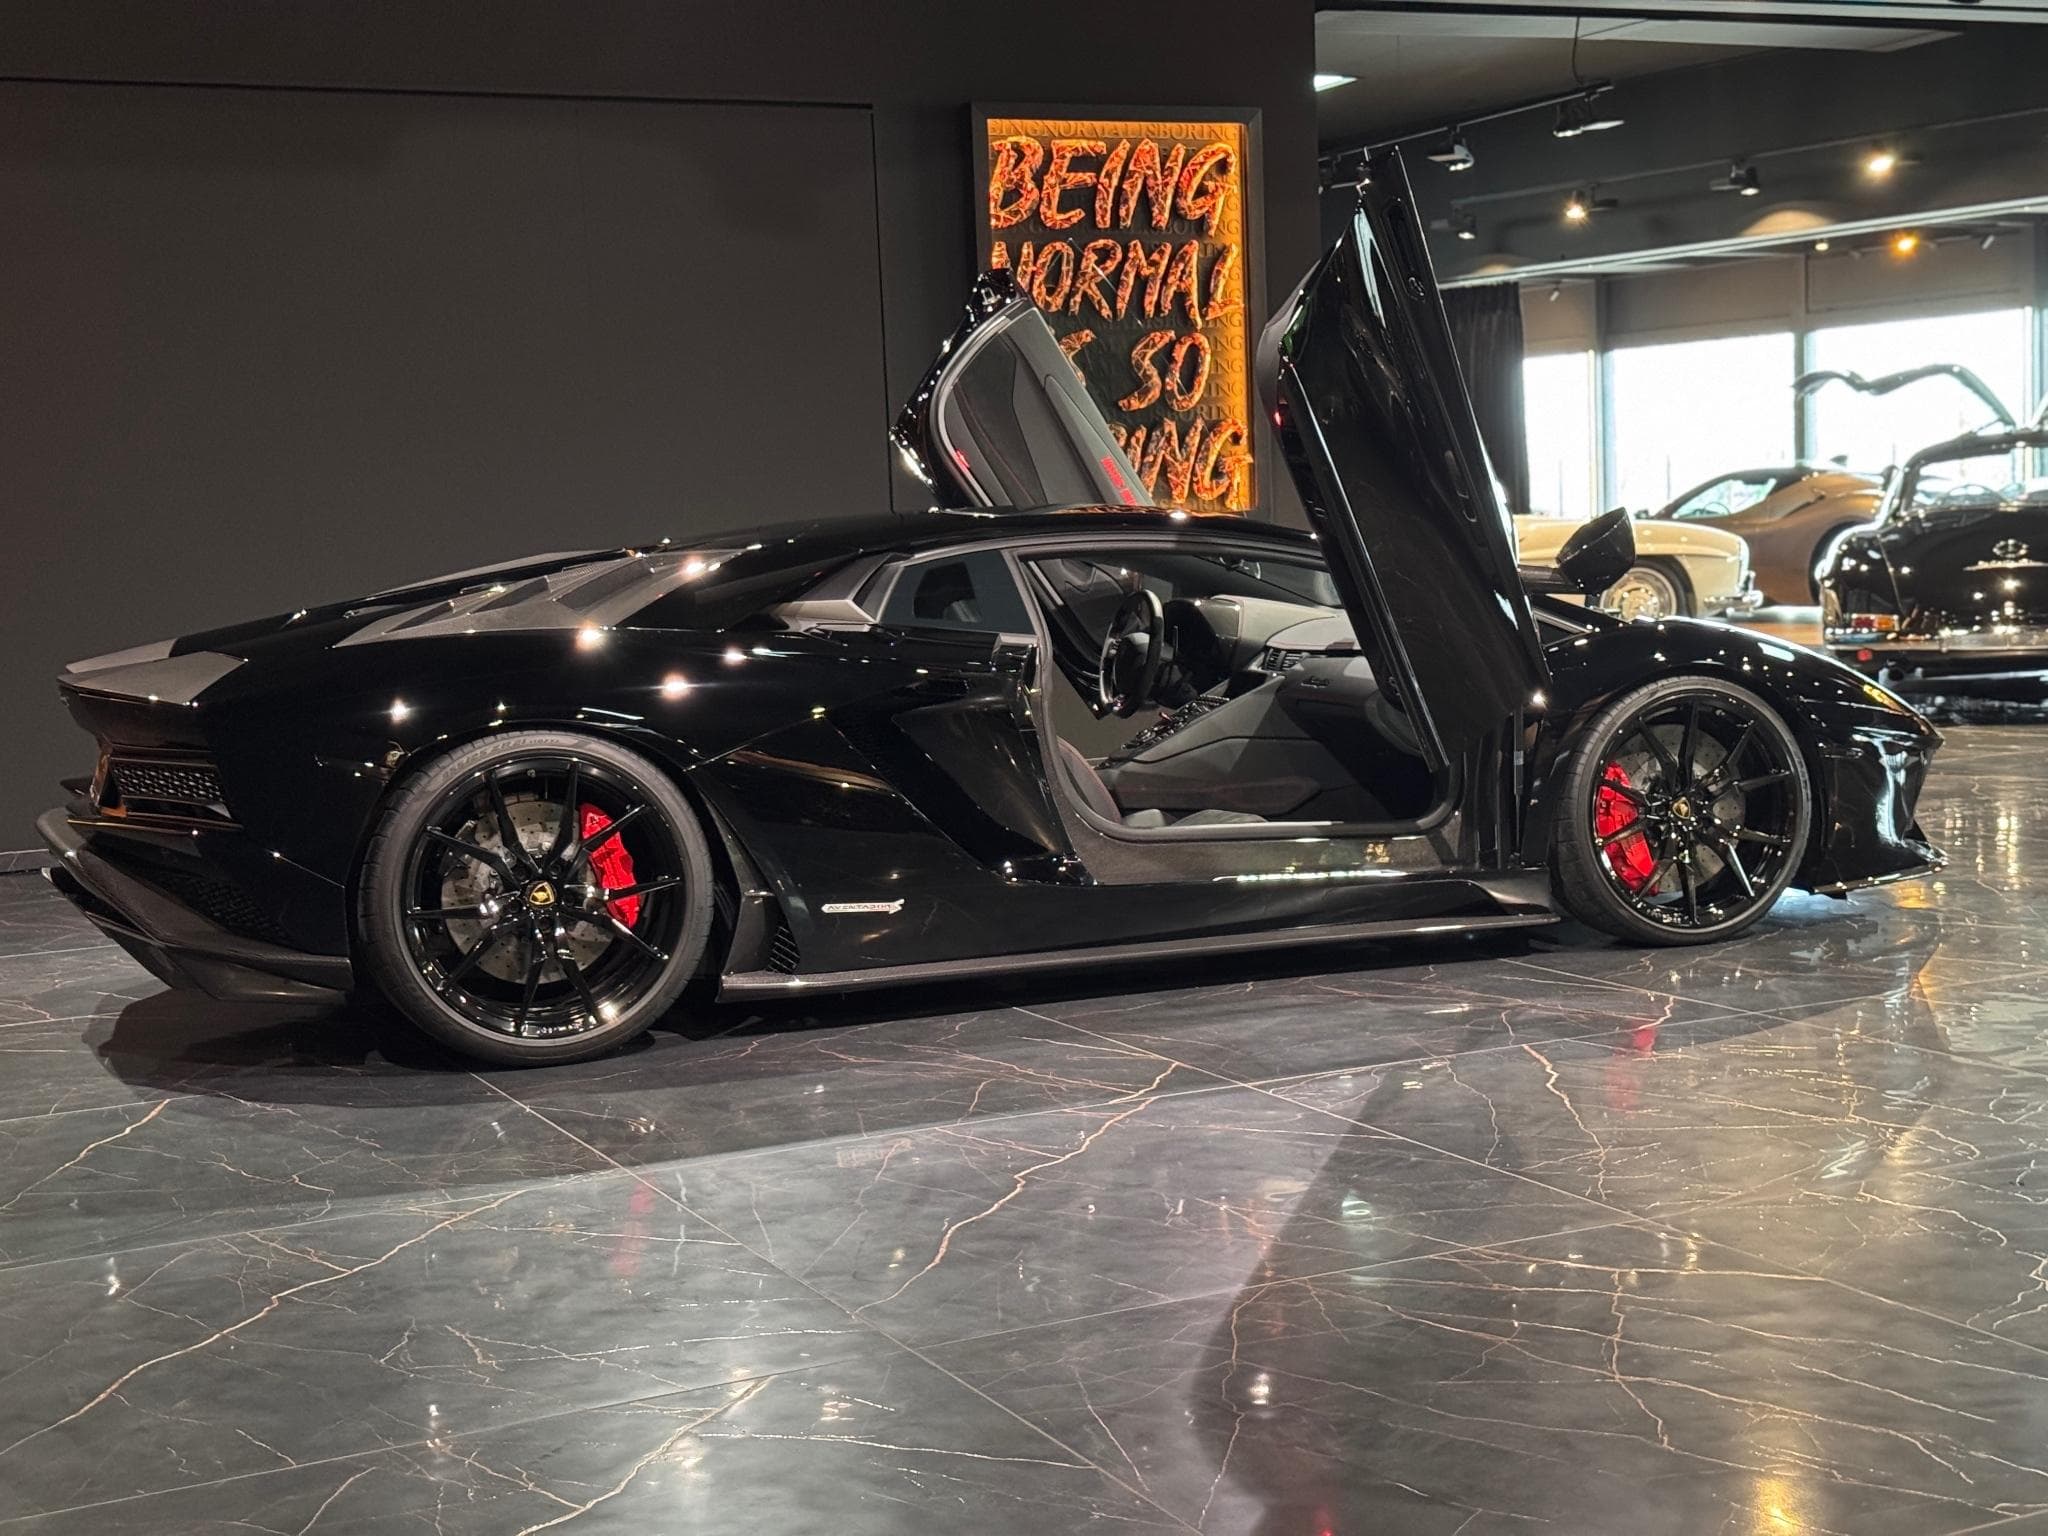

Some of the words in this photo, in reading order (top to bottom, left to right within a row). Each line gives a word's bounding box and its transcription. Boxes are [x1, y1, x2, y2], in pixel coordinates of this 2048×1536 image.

[989, 136, 1239, 238] BEING
[991, 239, 1245, 330] NORMAL
[1117, 329, 1211, 412] SO
